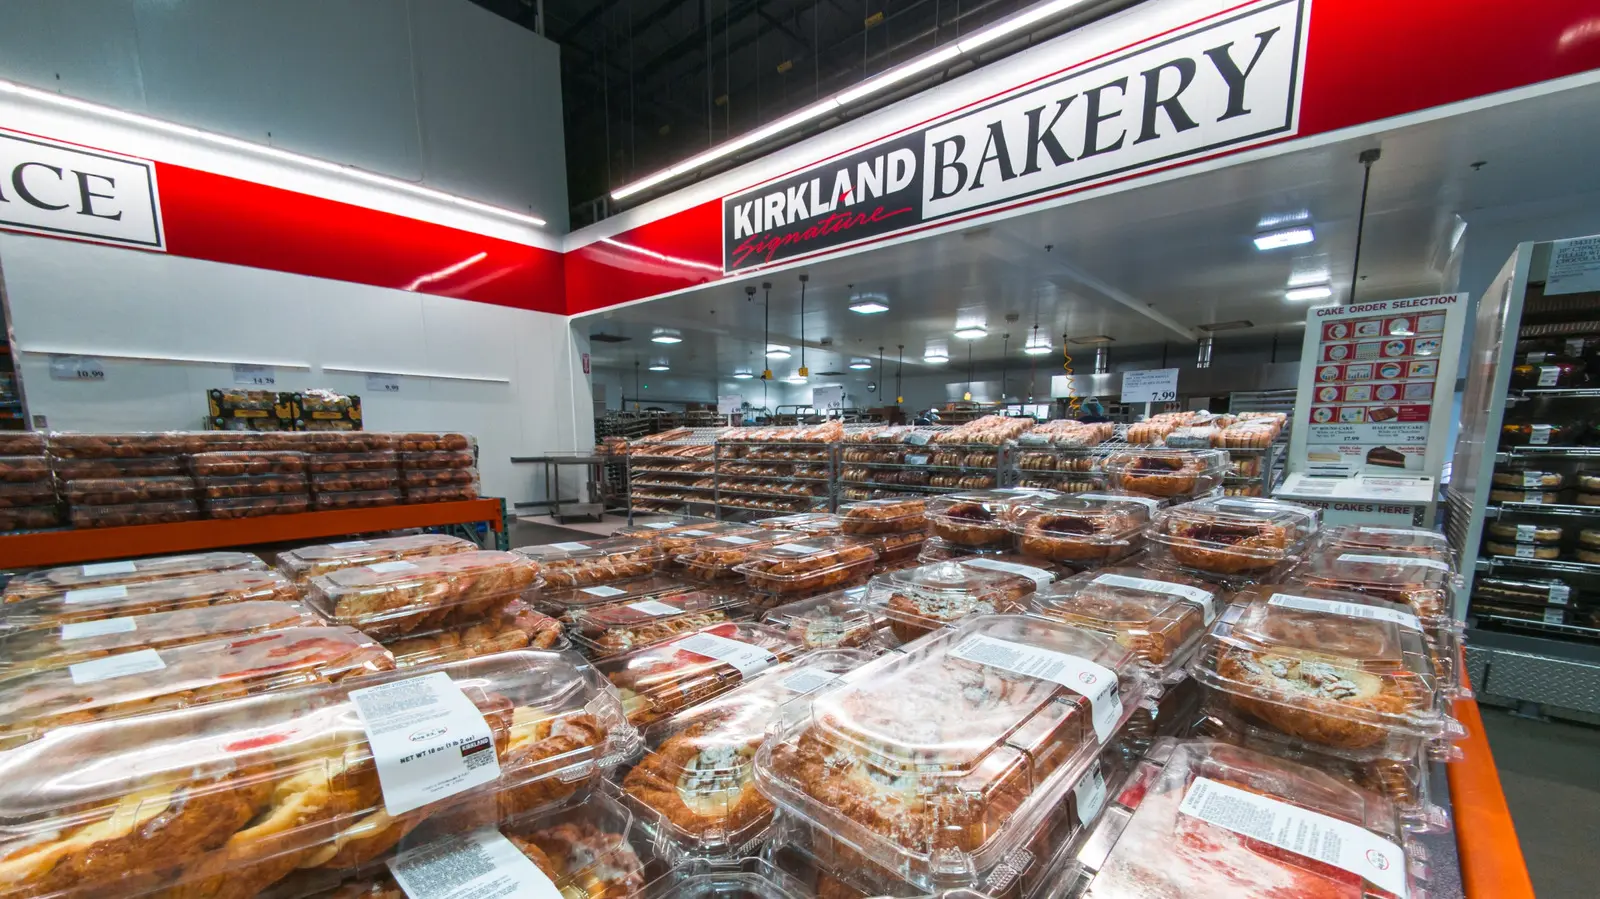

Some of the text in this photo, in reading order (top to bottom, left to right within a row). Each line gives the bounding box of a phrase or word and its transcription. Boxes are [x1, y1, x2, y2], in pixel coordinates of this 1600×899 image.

[928, 26, 1281, 202] BAKERY
[0, 161, 123, 221] CE
[734, 148, 917, 240] KIRKLAND
[732, 205, 912, 267] Signature
[1316, 295, 1458, 317] CAKE ORDER SELECTION
[76, 370, 104, 378] 10.99
[1152, 391, 1175, 401] 7.99
[1333, 503, 1374, 513] CAKES
[1378, 505, 1411, 515] HERE
[400, 754, 414, 765] NET
[416, 751, 427, 760] WT
[436, 745, 444, 753] oz
[452, 739, 459, 747] lb
[460, 737, 465, 745] 2
[465, 734, 475, 744] oz)
[462, 737, 490, 752] KIRKLAND
